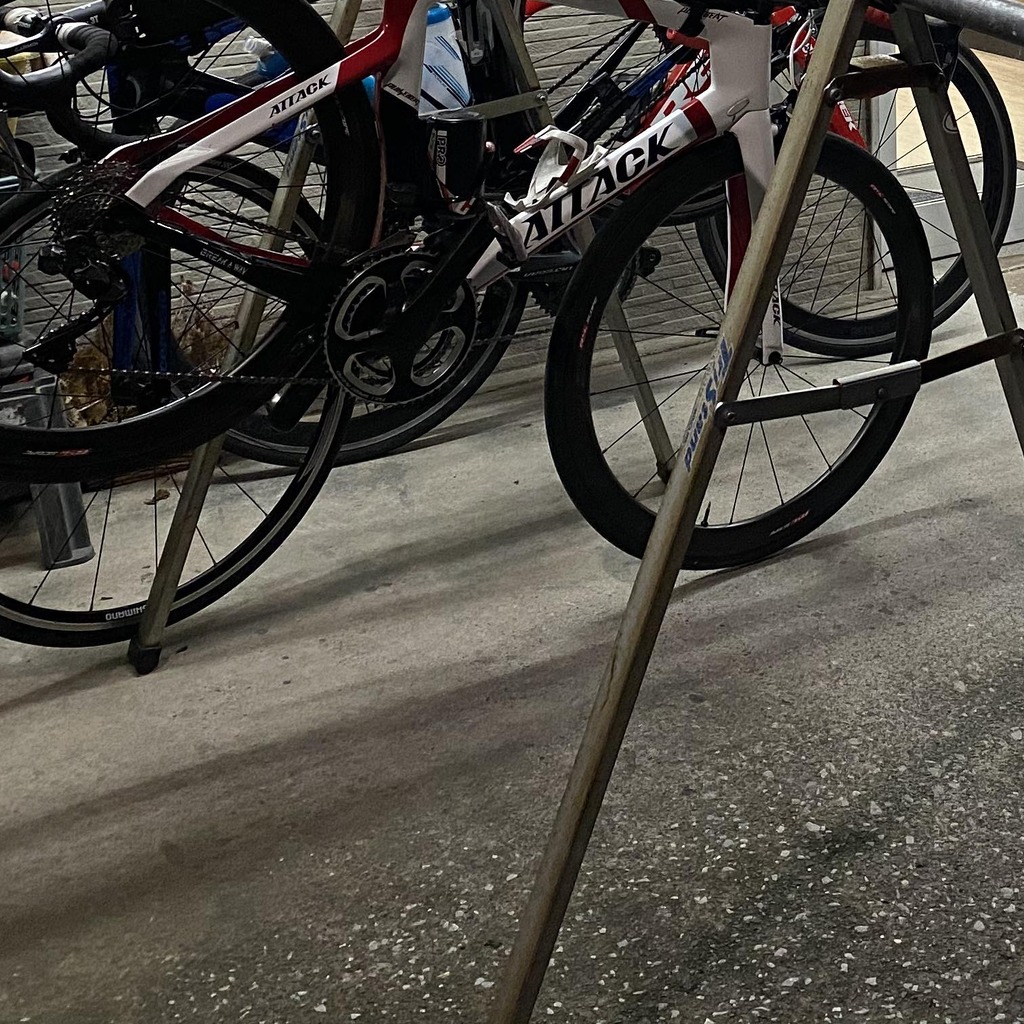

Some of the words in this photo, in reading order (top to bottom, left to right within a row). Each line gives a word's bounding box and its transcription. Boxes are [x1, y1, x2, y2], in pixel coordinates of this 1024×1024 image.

[269, 74, 331, 118] ATTACK
[436, 136, 447, 166] PRO
[523, 122, 680, 248] ATTACK
